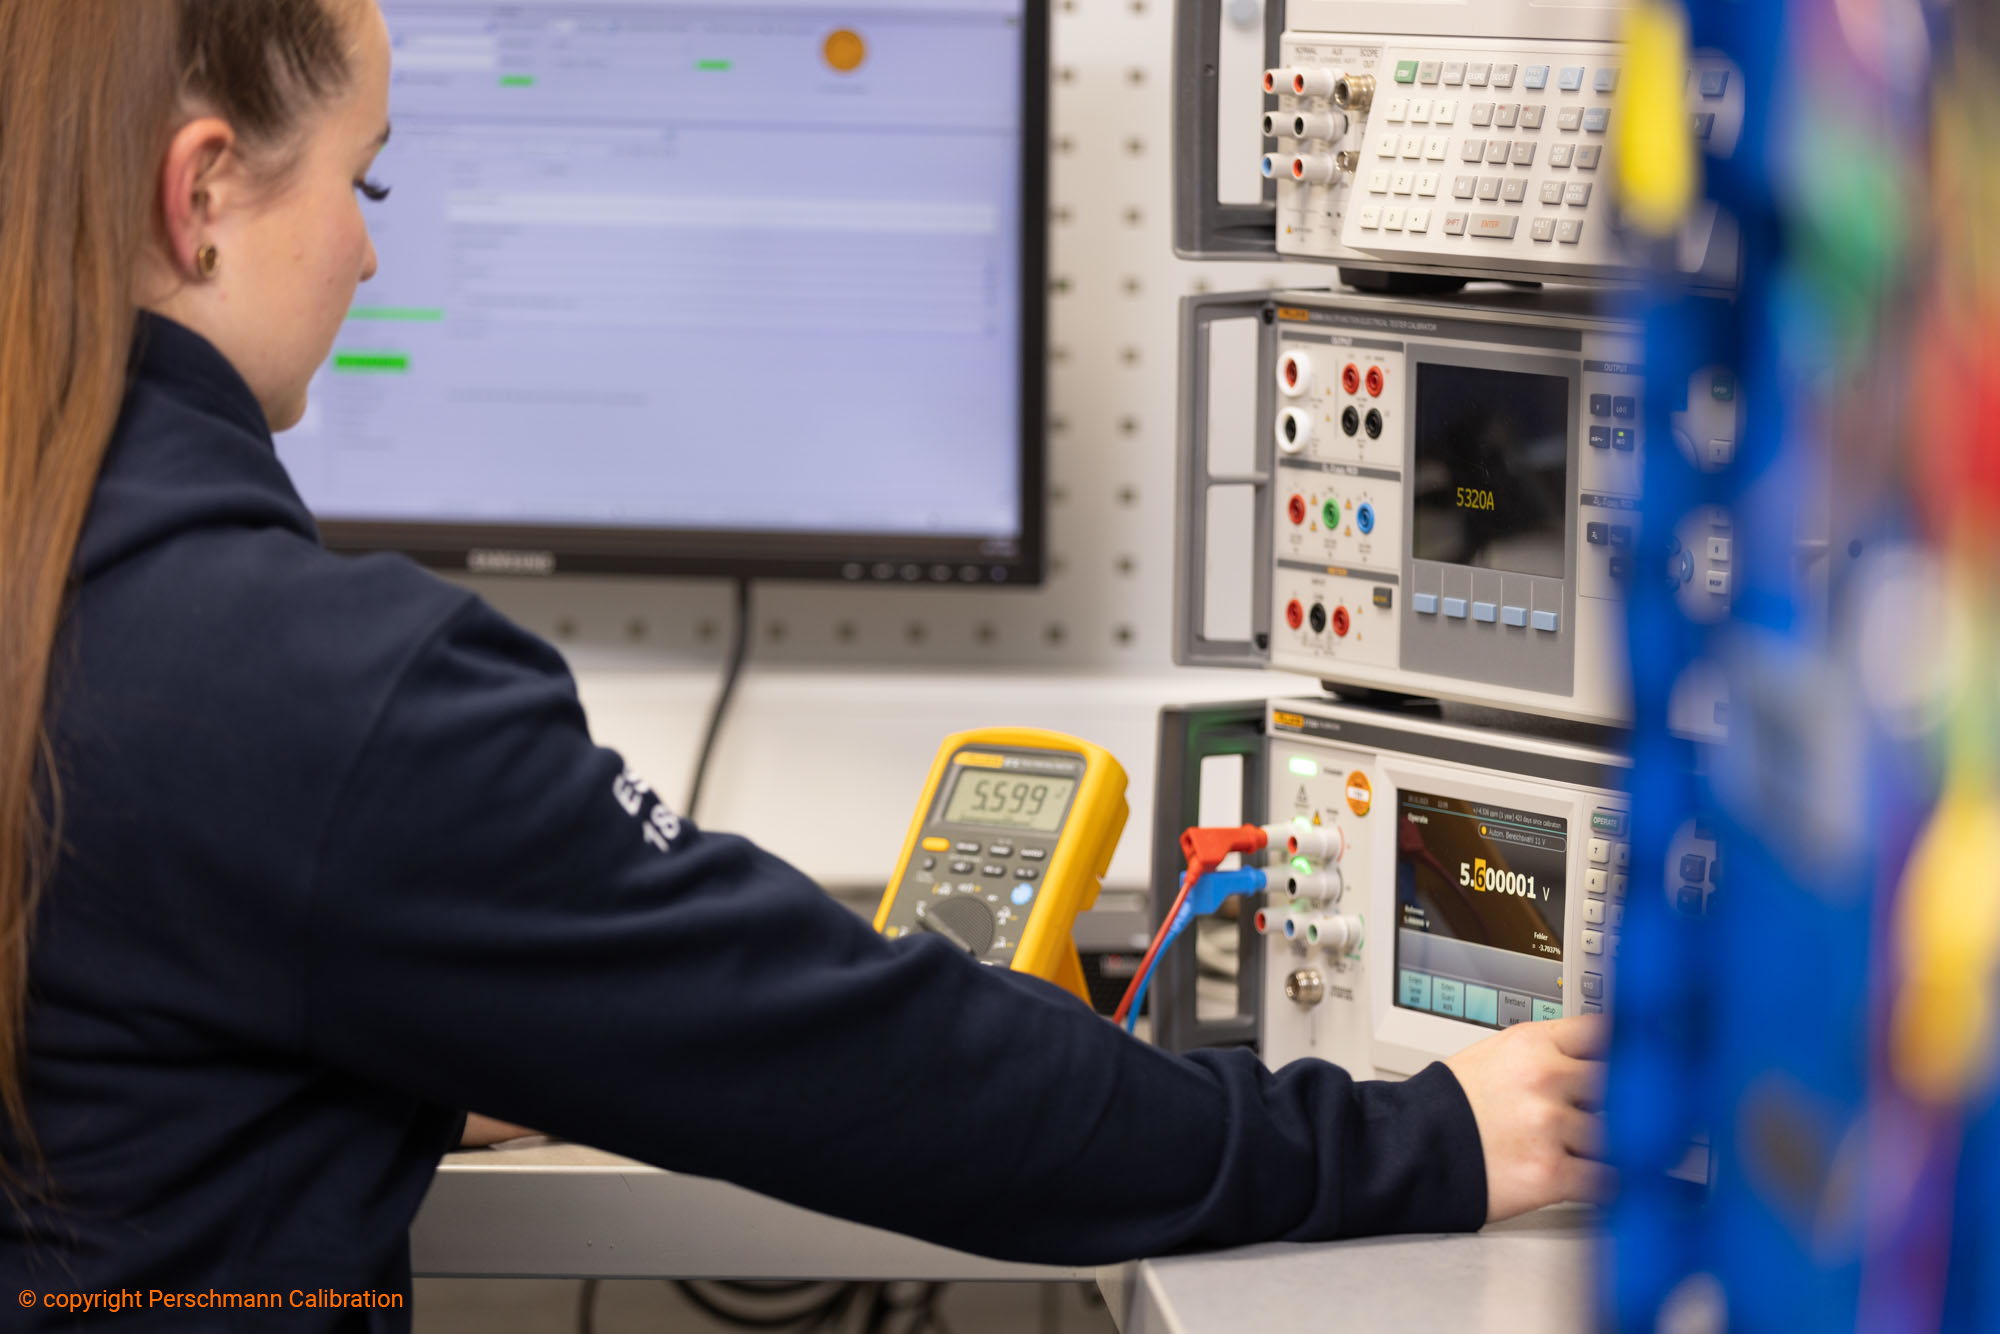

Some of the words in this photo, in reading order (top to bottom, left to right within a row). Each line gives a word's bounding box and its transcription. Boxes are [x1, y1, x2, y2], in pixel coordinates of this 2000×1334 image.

[1456, 487, 1495, 511] 5320A
[1543, 820, 1561, 829] calibration
[1593, 816, 1617, 827] OPERATE
[1460, 862, 1536, 899] 5.600001
[1542, 886, 1550, 902] V
[1543, 1005, 1556, 1015] Setup
